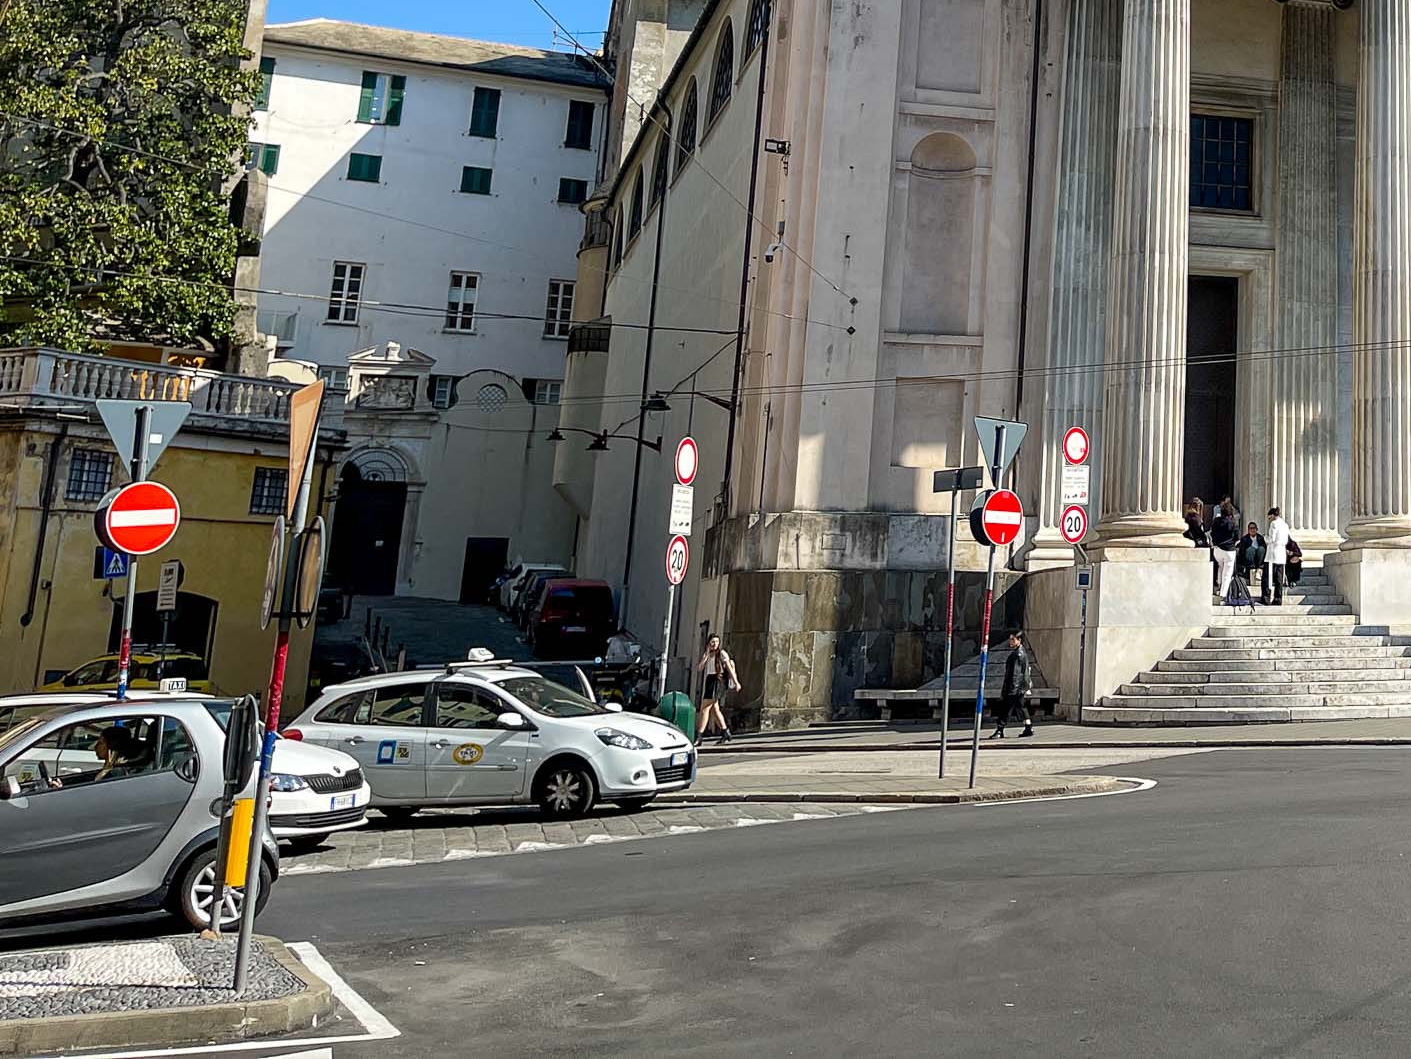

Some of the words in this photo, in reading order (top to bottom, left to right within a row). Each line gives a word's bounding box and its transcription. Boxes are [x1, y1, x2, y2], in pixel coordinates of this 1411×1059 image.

[1067, 516, 1081, 533] 20
[672, 549, 684, 571] 20
[169, 681, 185, 690] TAXI
